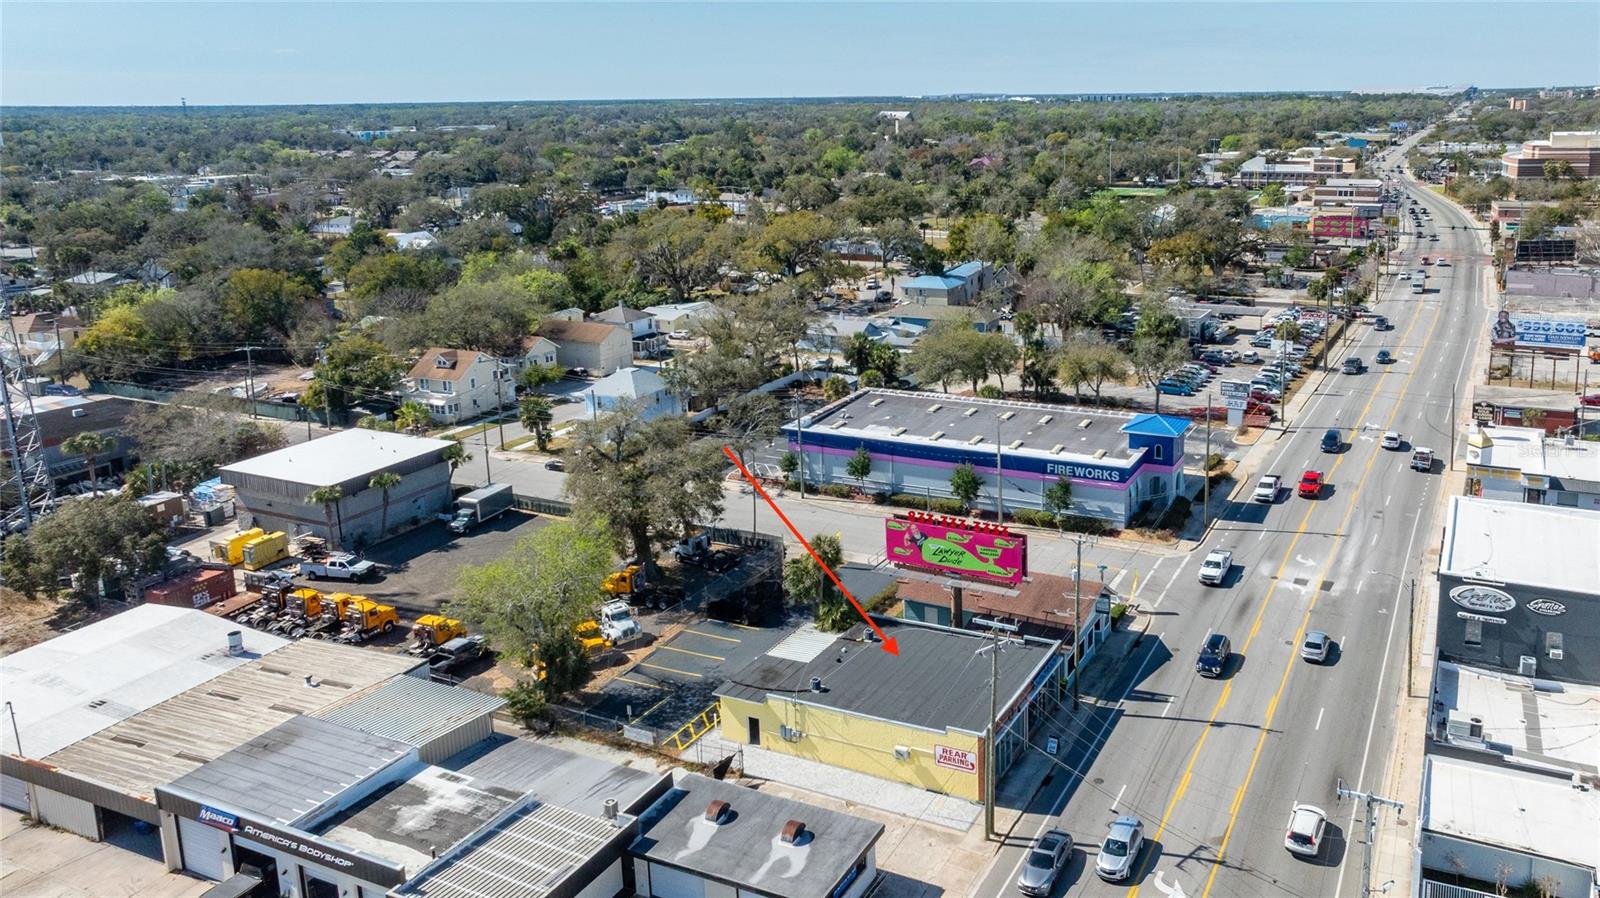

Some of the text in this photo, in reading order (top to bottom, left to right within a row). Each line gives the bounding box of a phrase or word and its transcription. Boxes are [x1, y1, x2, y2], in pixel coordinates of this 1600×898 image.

[1047, 463, 1120, 481] FIREWORKS
[939, 755, 970, 767] PARKING
[942, 748, 967, 759] REAR
[200, 809, 234, 826] Maaco
[244, 825, 354, 867] AMERICA'S BODYSHOP
